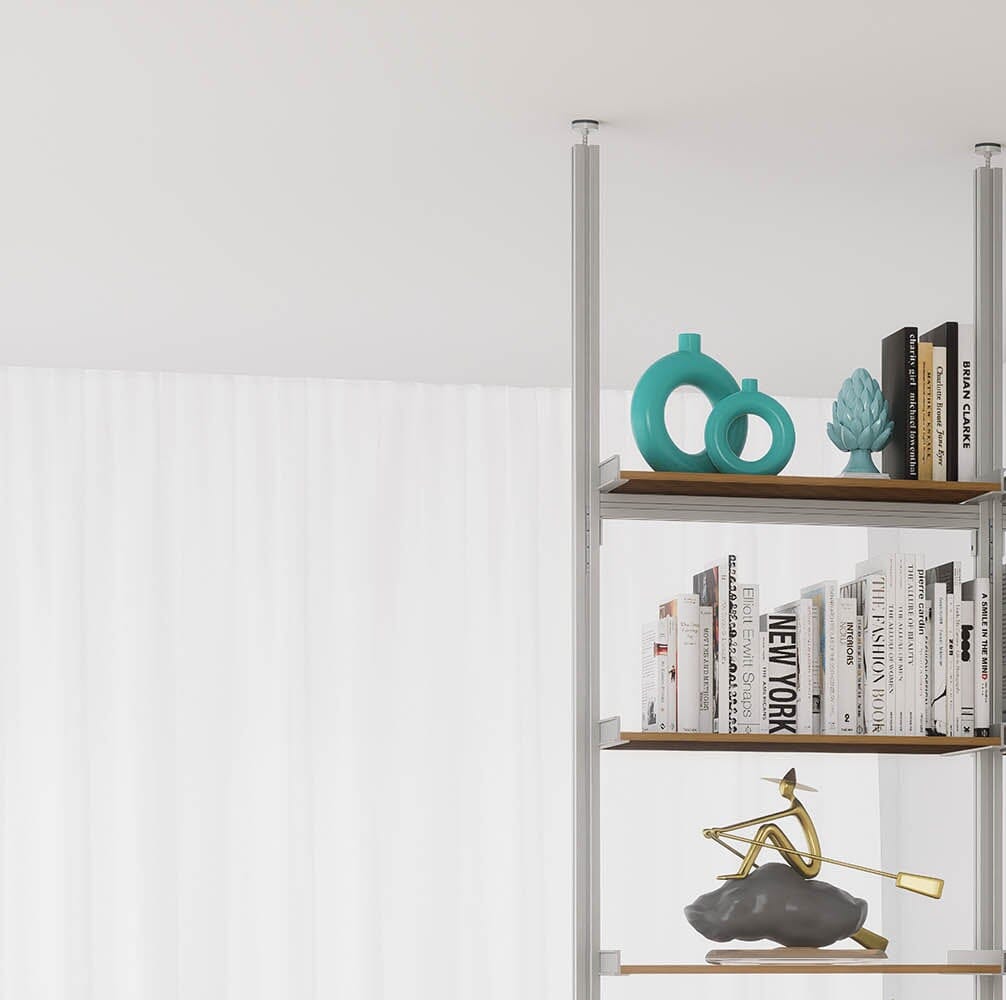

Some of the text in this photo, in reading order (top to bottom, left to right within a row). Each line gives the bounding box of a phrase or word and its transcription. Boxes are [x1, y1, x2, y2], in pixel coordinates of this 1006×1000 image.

[908, 334, 917, 475] charity girl michael lowenthal
[963, 361, 971, 448] BRIAN CLARKE
[742, 588, 754, 718] Elliott Erwitt Snaps
[769, 615, 797, 734] NEW YORK
[846, 622, 854, 665] INTERIORS
[872, 576, 885, 733] THE FASHION BOOK
[981, 628, 988, 638] IN
[844, 713, 850, 722] 2
